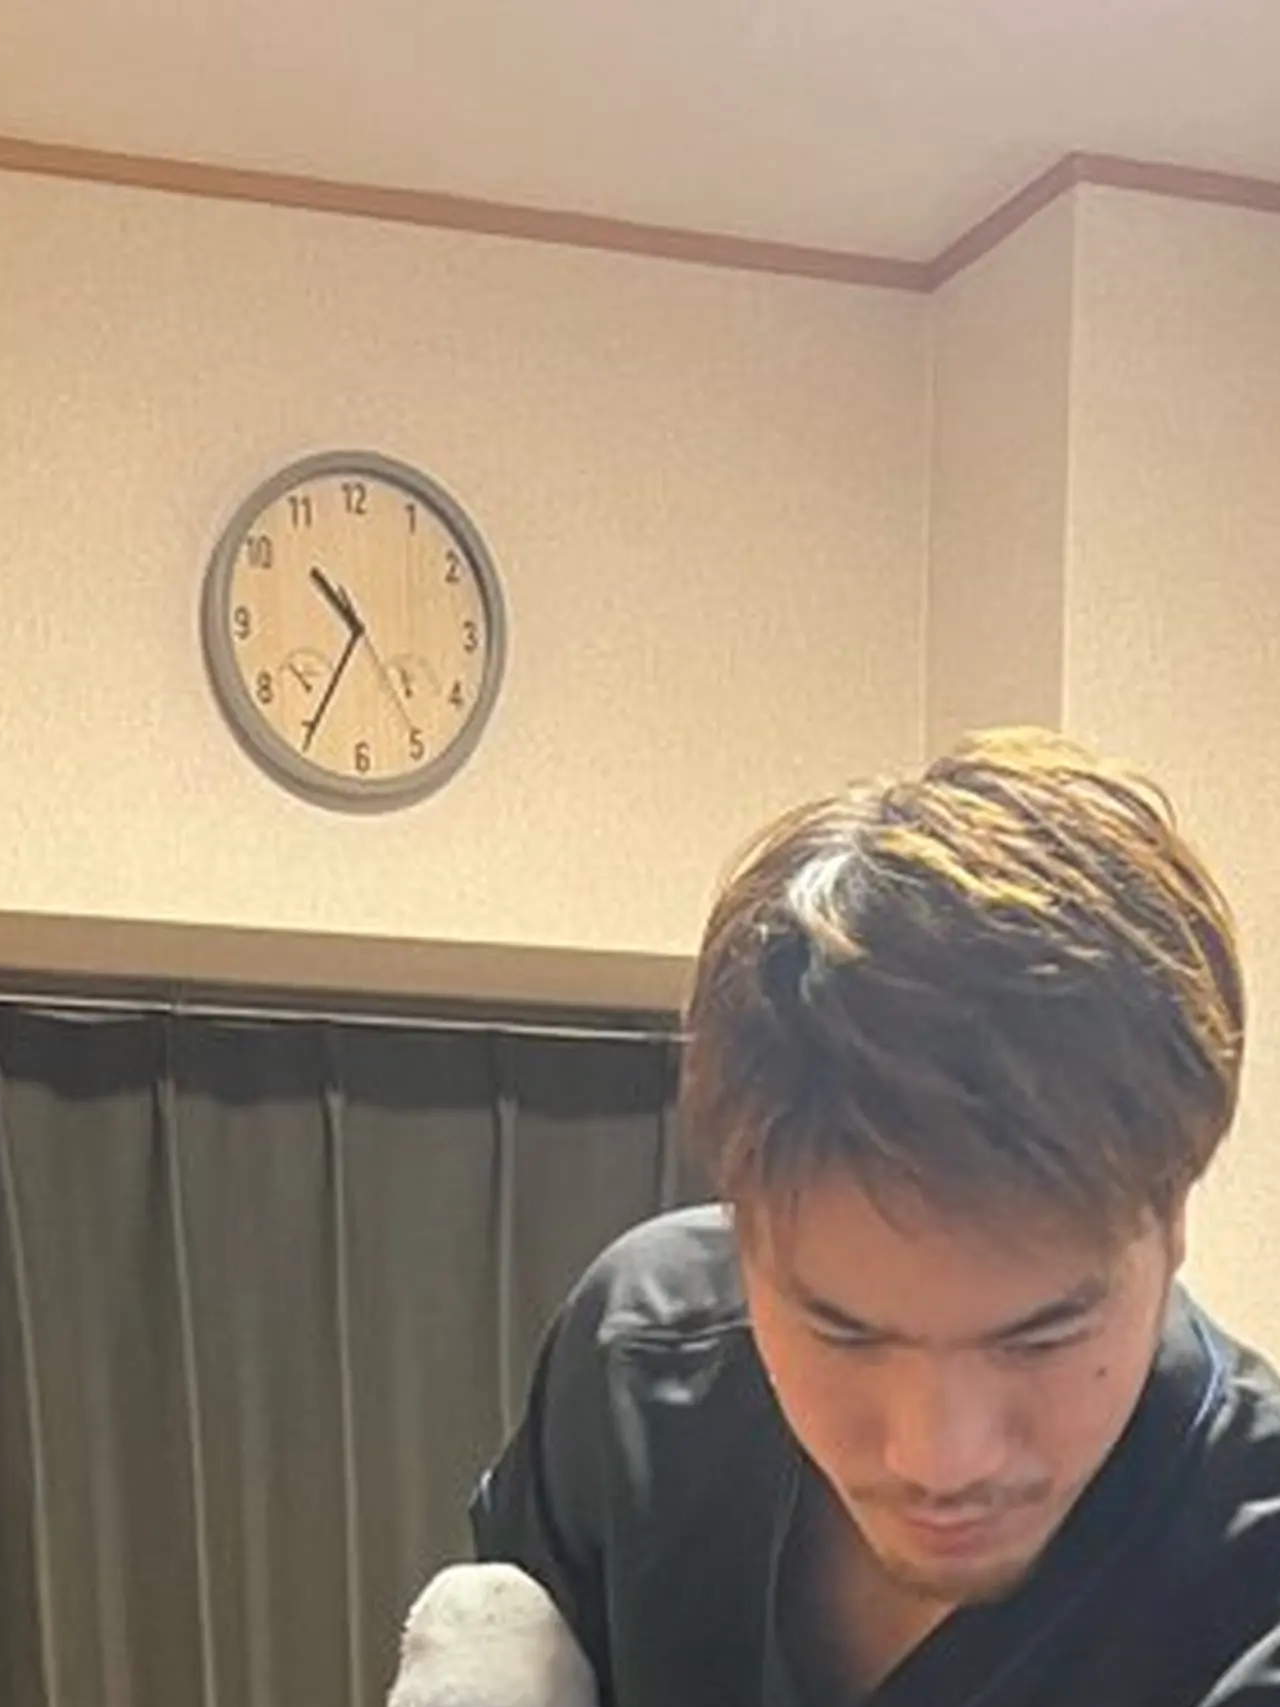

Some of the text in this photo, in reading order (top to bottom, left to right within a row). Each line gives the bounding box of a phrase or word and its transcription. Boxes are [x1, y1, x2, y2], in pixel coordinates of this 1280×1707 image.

[288, 496, 312, 528] 11
[341, 483, 367, 515] 12
[406, 504, 417, 534] 1
[247, 536, 273, 569] 10
[445, 551, 460, 584] 2
[234, 606, 250, 640] 9
[463, 621, 478, 653] 3
[257, 671, 273, 704] 8
[449, 681, 462, 706] 4
[355, 742, 370, 773] 6
[409, 729, 425, 760] 5
